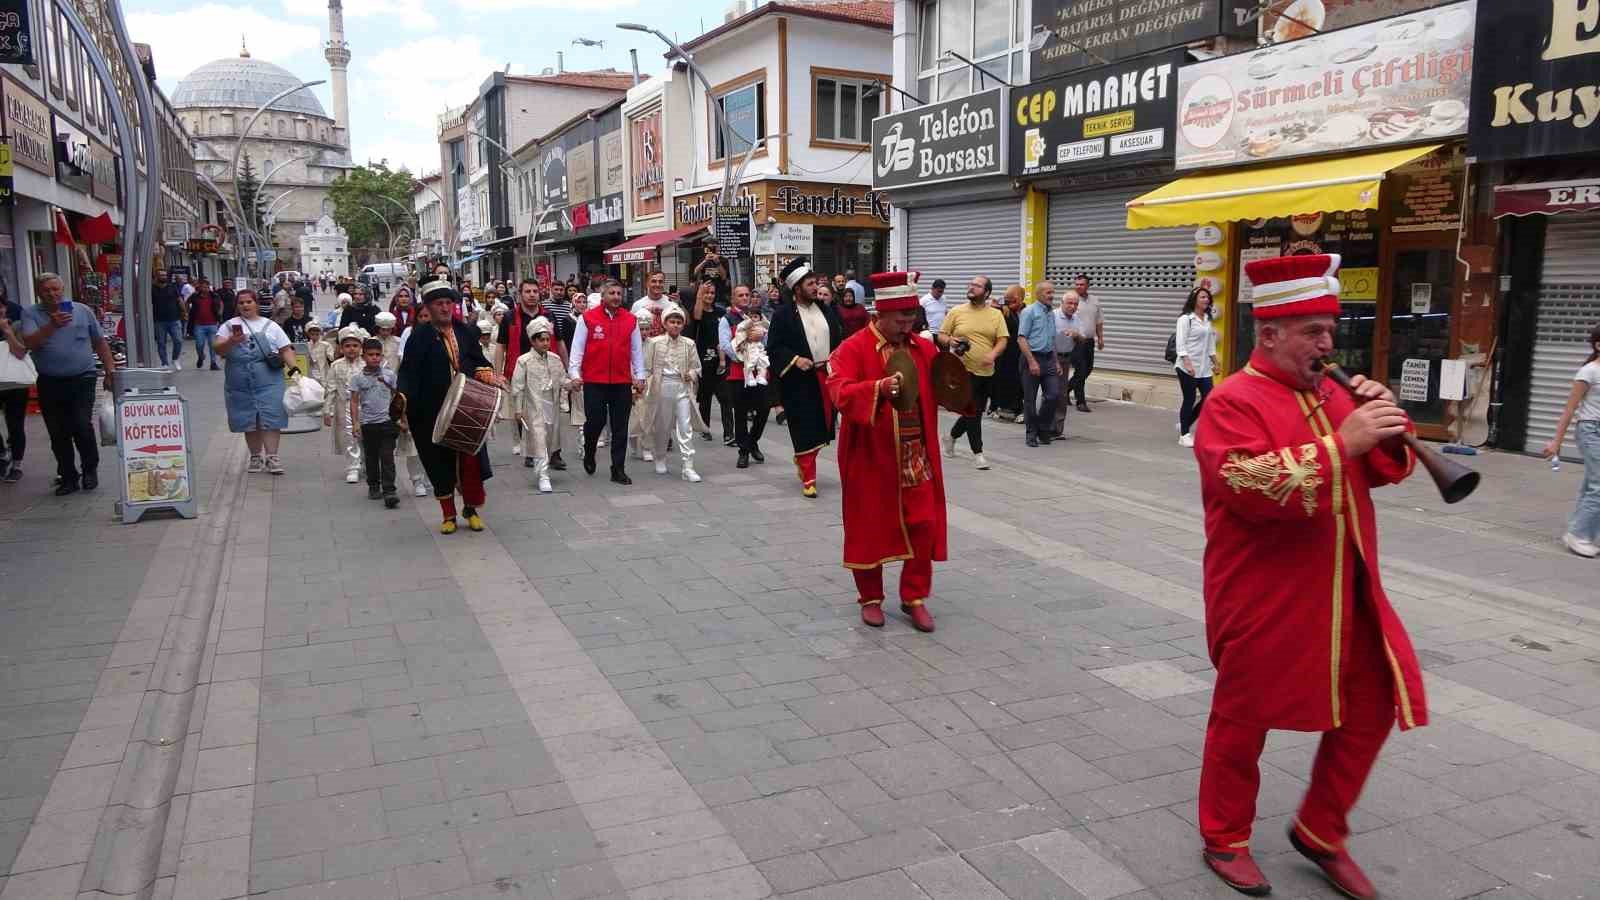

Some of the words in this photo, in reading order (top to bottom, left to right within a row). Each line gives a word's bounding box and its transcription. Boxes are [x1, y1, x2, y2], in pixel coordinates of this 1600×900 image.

[1085, 26, 1129, 49] EKRAN
[1134, 4, 1203, 36] DEĞİŞİMİ
[1016, 87, 1057, 126] CEP
[1063, 63, 1172, 118] MARKET
[1236, 69, 1344, 113] Sürmeli
[1351, 41, 1473, 98] Çiftliği
[919, 102, 995, 143] Telefon
[1073, 143, 1102, 156] TELEFONU
[1119, 134, 1154, 149] AKSESUAR
[918, 143, 996, 178] Borsası
[124, 402, 156, 417] BÜYÜK
[158, 399, 180, 416] CAMİ
[124, 420, 182, 441] KÖFTECİSİ
